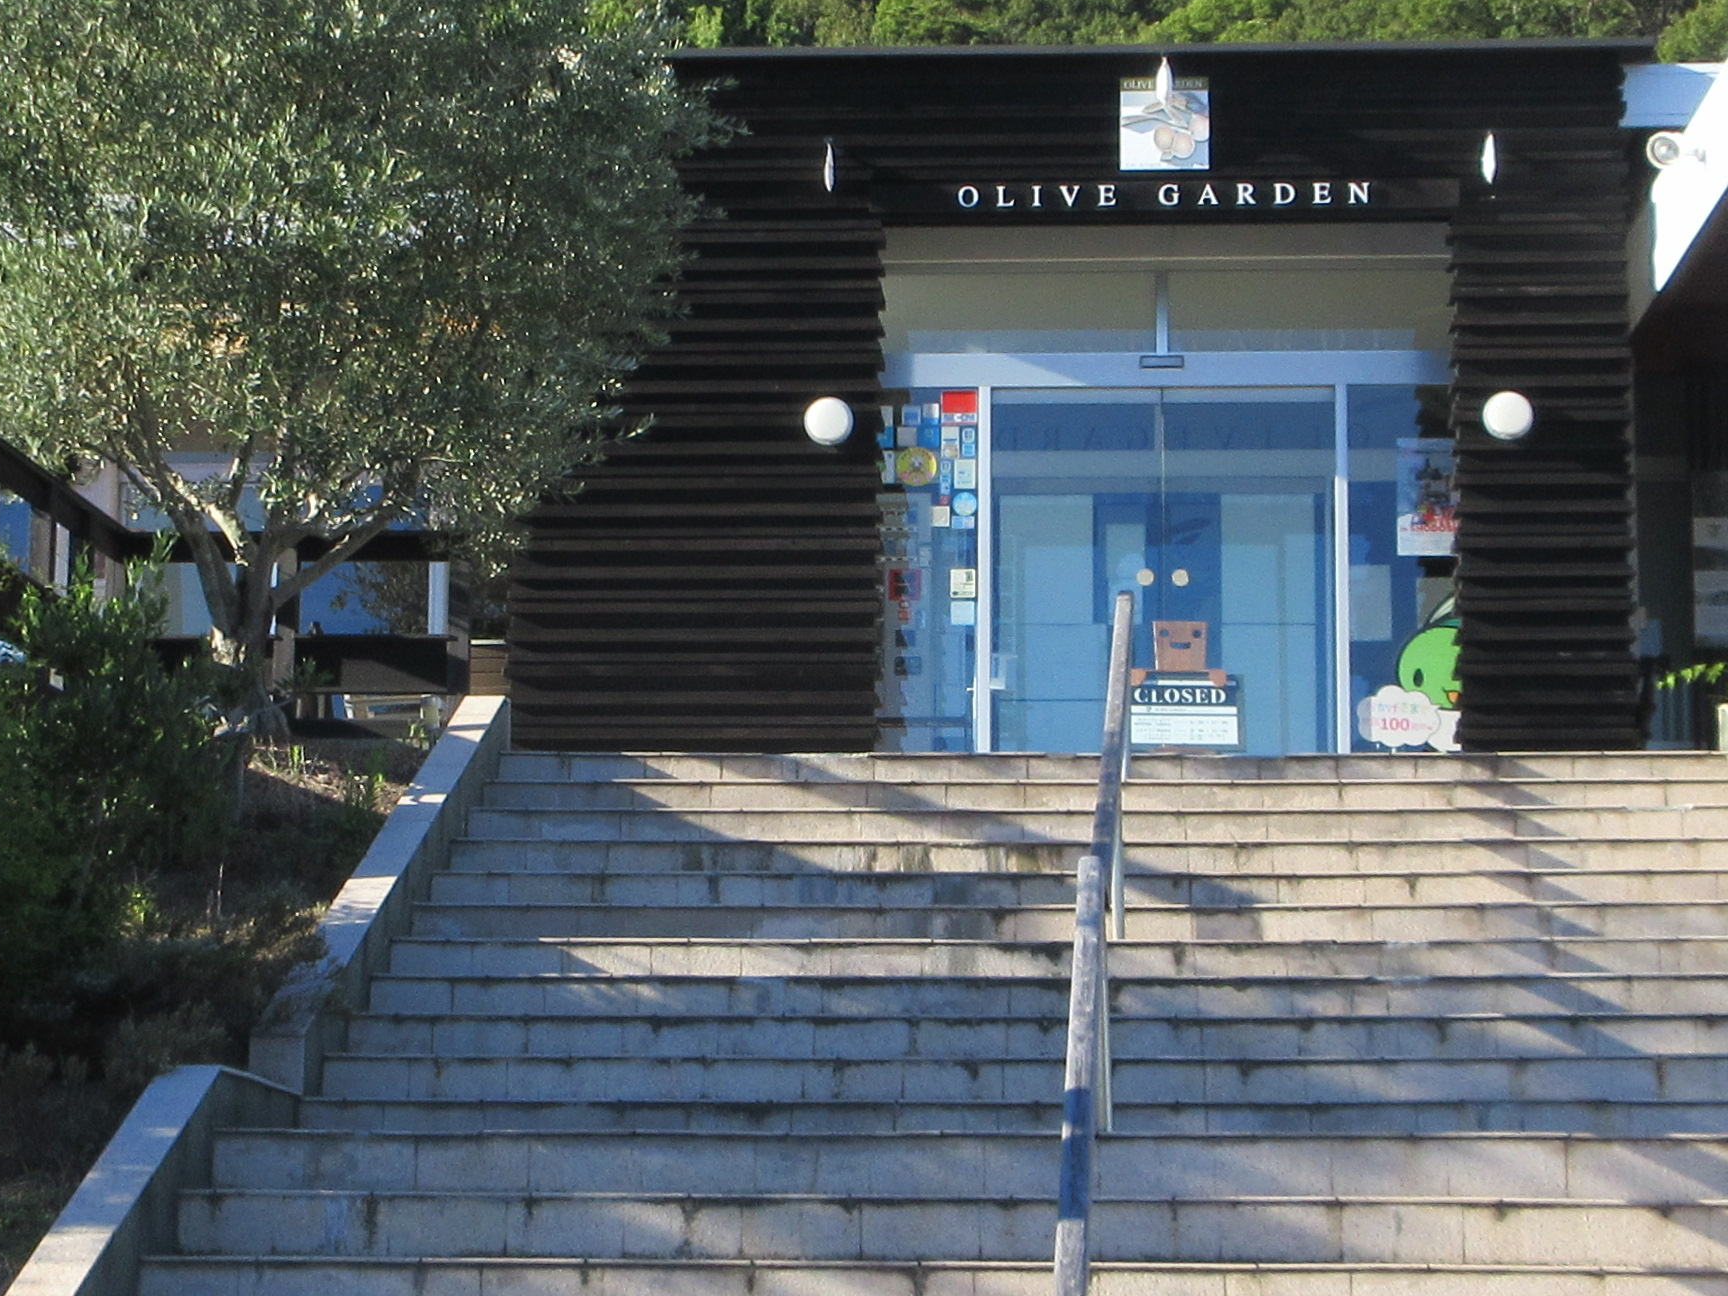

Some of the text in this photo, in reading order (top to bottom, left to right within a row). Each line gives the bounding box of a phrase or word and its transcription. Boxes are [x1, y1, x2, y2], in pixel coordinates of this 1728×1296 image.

[957, 181, 1371, 208] OLIVE GARDEN
[1133, 687, 1227, 704] CLOSED
